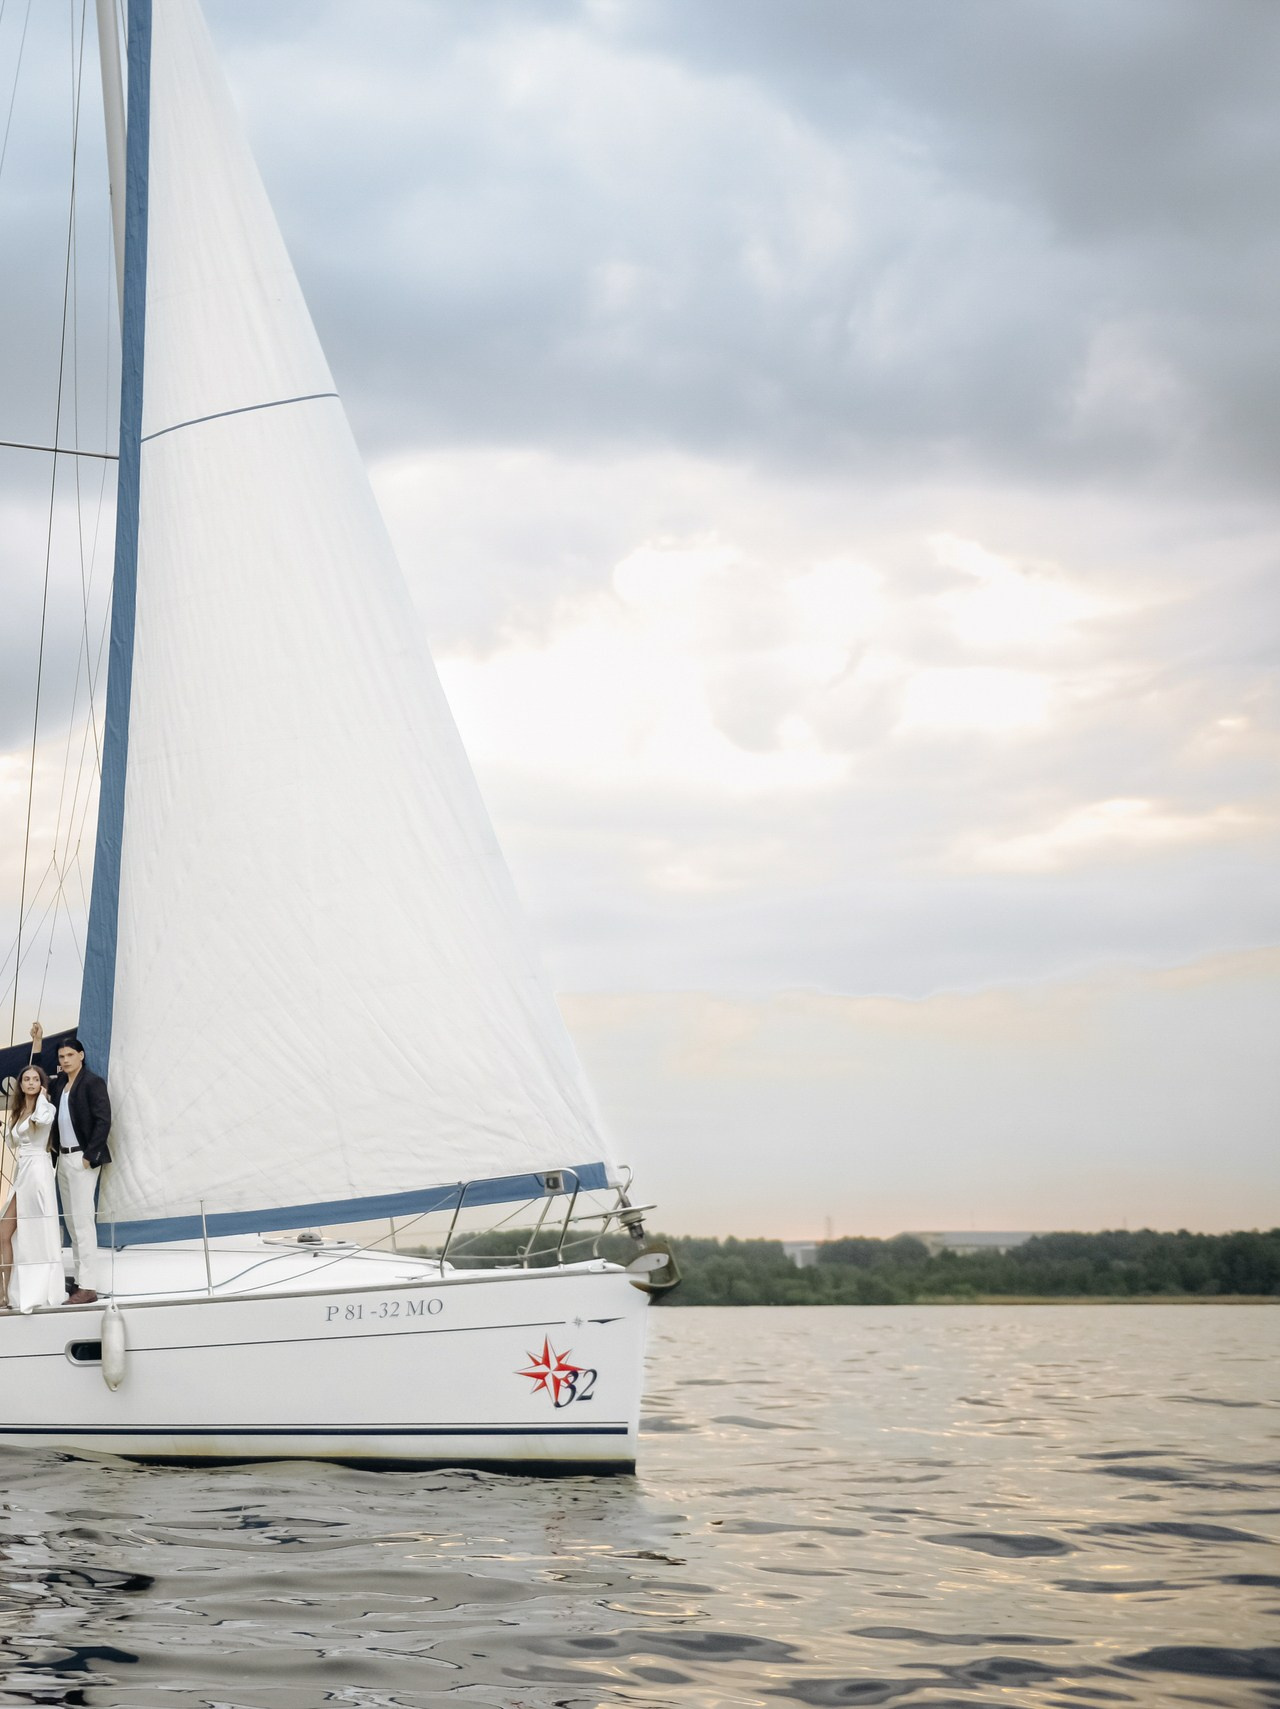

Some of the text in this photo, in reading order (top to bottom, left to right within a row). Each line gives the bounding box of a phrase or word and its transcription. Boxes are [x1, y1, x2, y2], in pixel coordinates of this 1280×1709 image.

[325, 1306, 339, 1322] P
[405, 1298, 443, 1316] MO
[554, 1368, 598, 1408] 32
